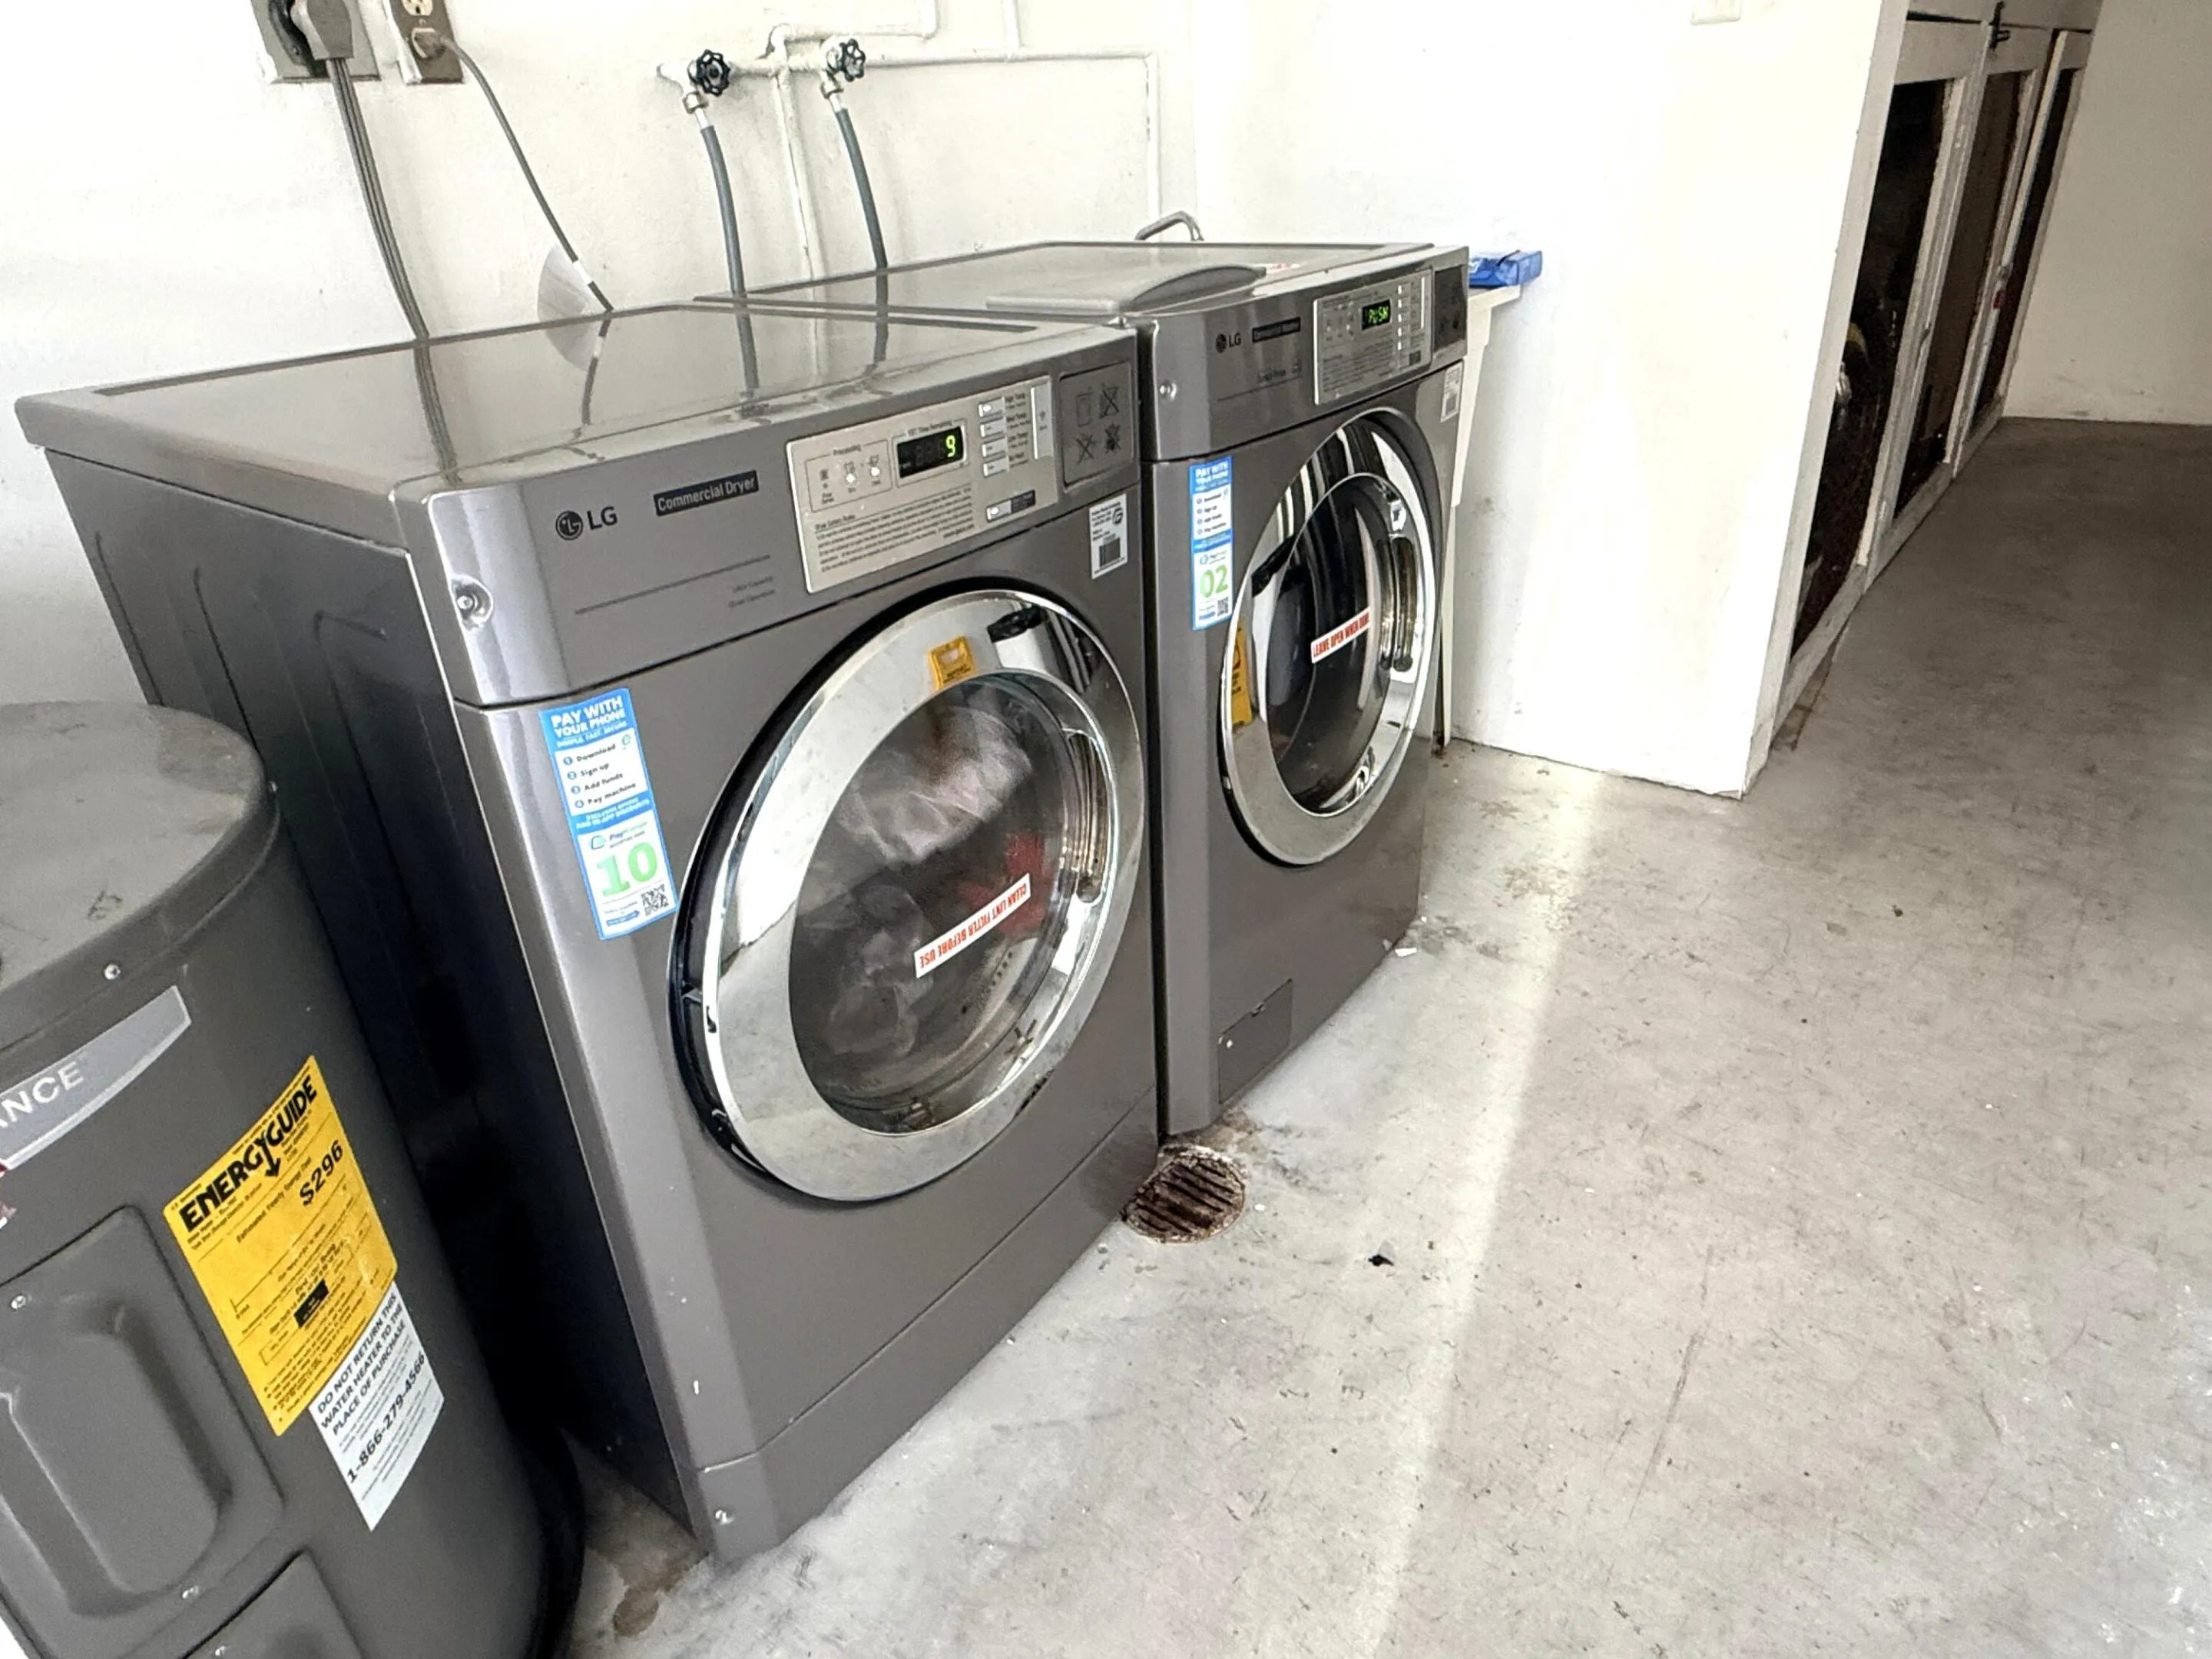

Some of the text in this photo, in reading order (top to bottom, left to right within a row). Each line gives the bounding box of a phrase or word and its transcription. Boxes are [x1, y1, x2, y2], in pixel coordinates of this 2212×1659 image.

[1229, 333, 1241, 348] LG
[945, 435, 955, 458] 9
[657, 478, 755, 511] Commercial Dryer
[588, 506, 618, 530] LG
[1200, 565, 1228, 598] 02
[1313, 638, 1330, 657] LEAVE
[1331, 630, 1344, 648] OPEN
[1345, 621, 1359, 638] WHEN
[551, 695, 623, 728] PAY WITH
[554, 708, 626, 738] YOUR PHONE
[576, 743, 616, 761] Download
[581, 767, 598, 776] Sign
[584, 773, 624, 790] Add funds
[604, 783, 636, 799] machine
[597, 842, 657, 896] 10
[919, 883, 1027, 968] CLEAN LINT FILTER BEFORE USE
[299, 1139, 343, 1206] $296
[237, 1210, 267, 1243] Estimated
[266, 1191, 284, 1210] Yearly
[317, 1293, 396, 1415] DO NOT RETURN THIS
[321, 1303, 404, 1429] WATER HEATER TO THE
[333, 1323, 406, 1435] PLACE OF PURCHASE
[347, 1353, 425, 1483] 1-866-279-4566
